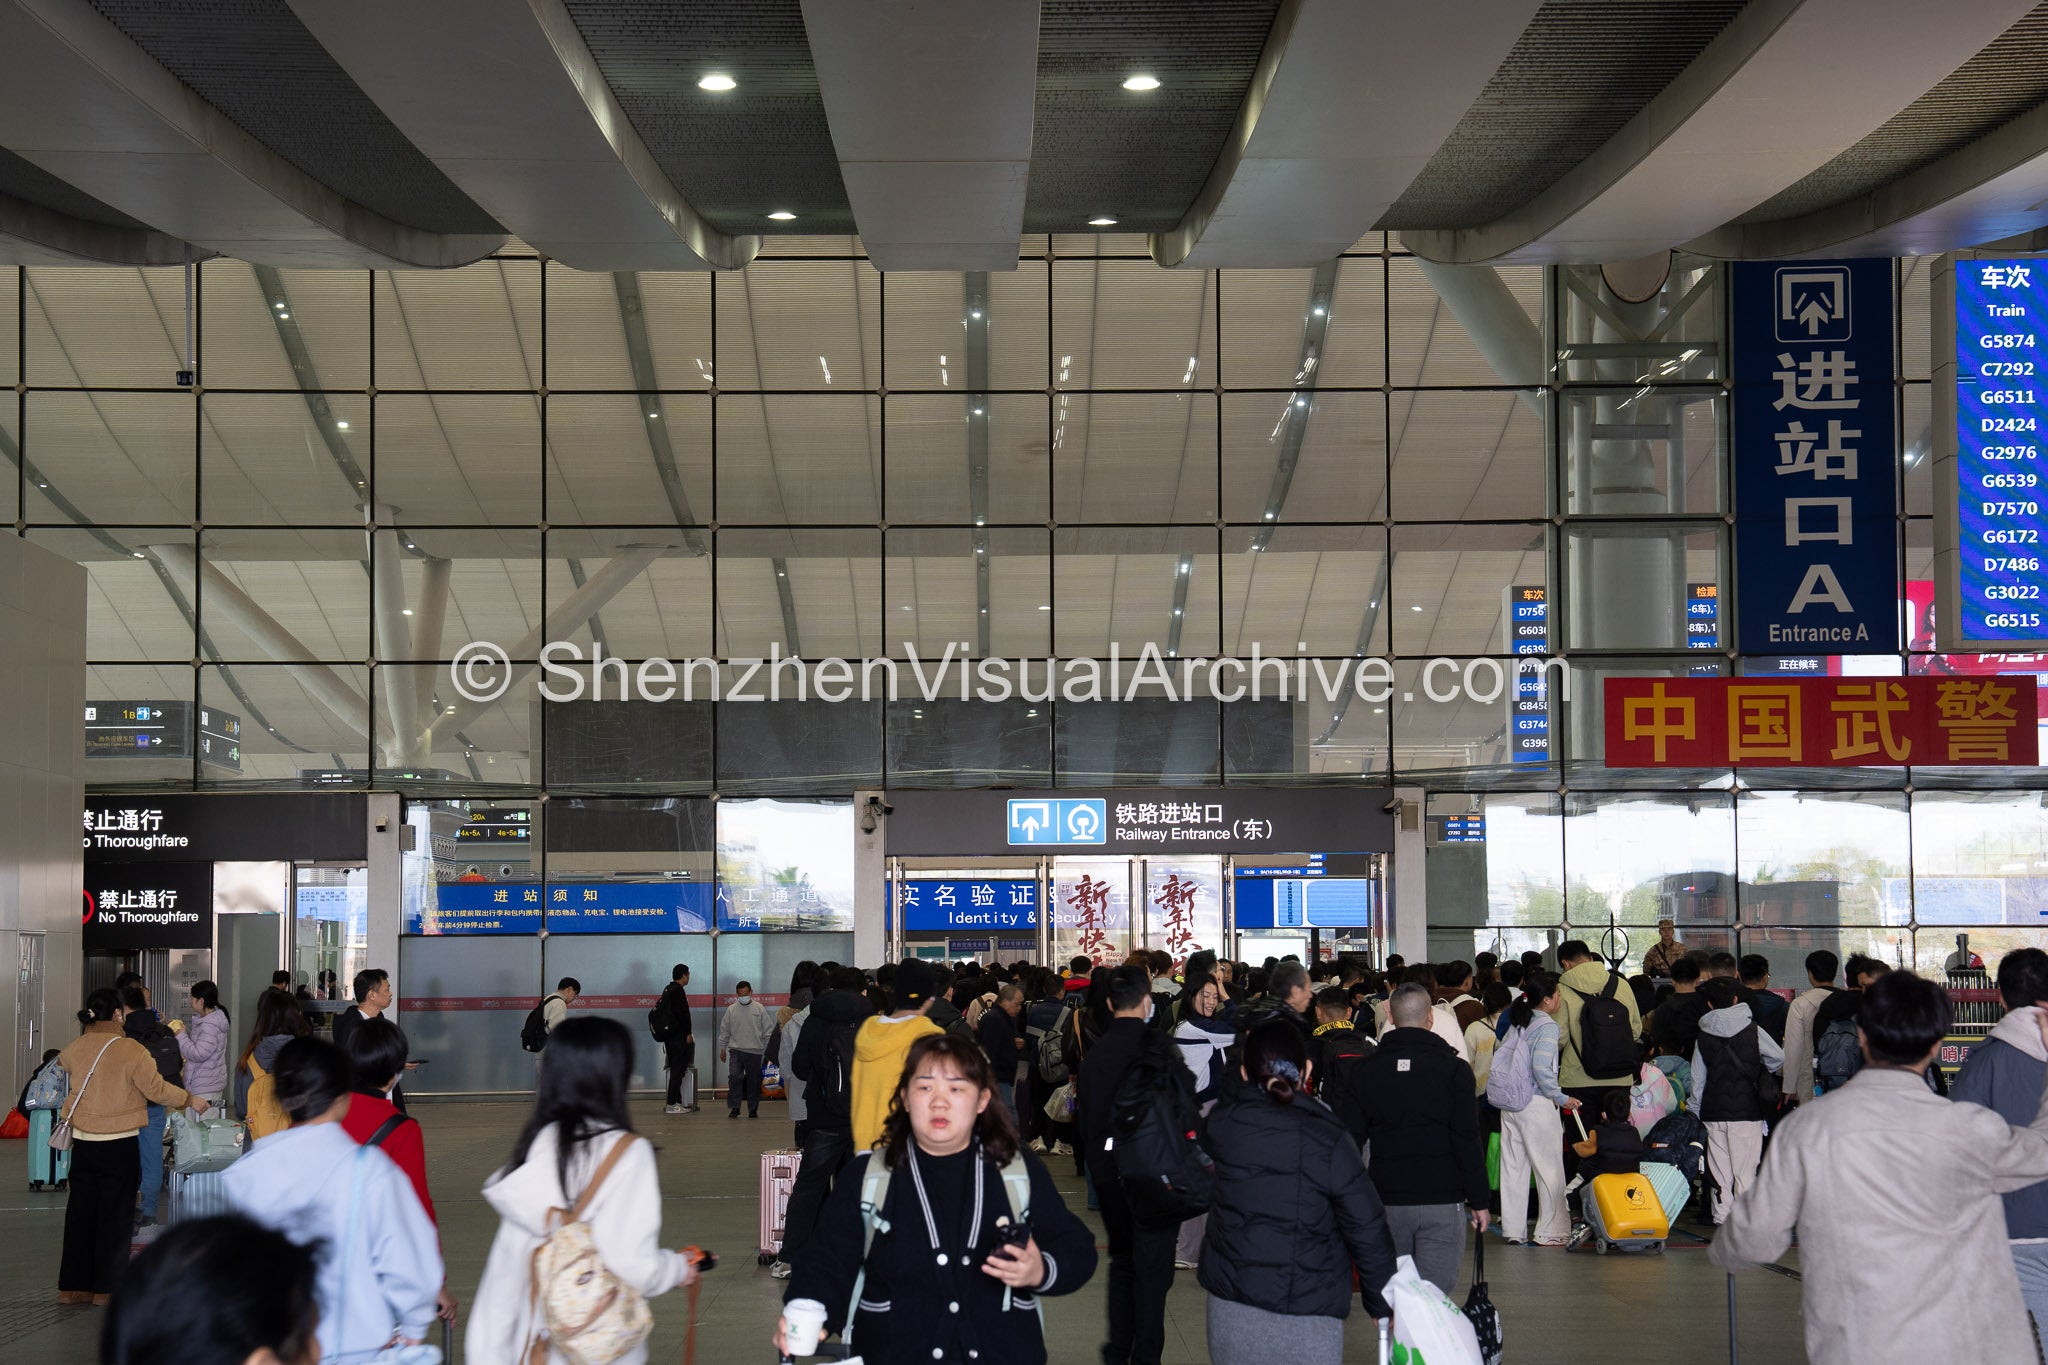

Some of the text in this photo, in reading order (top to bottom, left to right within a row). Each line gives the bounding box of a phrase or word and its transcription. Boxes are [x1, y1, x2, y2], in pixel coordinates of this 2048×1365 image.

[1981, 265, 2031, 290] 车次
[1987, 303, 2026, 318] Train
[1980, 335, 2036, 349] G5874
[1981, 362, 2035, 376] C7292
[1981, 391, 2036, 404] G6511
[1982, 418, 2037, 432] D2424
[1982, 446, 2038, 460] G2976
[1982, 474, 2038, 488] G6539
[1983, 502, 2039, 516] D7570
[1983, 530, 2039, 544] G6172
[1984, 557, 2040, 572] D7486
[1523, 590, 1544, 600] 车次
[1786, 564, 1854, 614] A
[1985, 585, 2040, 600] G3022
[1985, 613, 2041, 628] G6515
[1769, 623, 1869, 642] Entrance A
[1779, 660, 1818, 670] 正在候车
[1623, 680, 2018, 762] 中国武警
[1115, 803, 1223, 825] 铁路进站口
[83, 834, 189, 850] o Thoroughfare
[1115, 828, 1231, 843] Railway Entrance
[99, 889, 177, 909] 禁止通行
[493, 889, 598, 903] 进站须知
[716, 887, 818, 903] 人工通道
[99, 911, 199, 924] No Thoroughfare
[950, 912, 1018, 926] Identity
